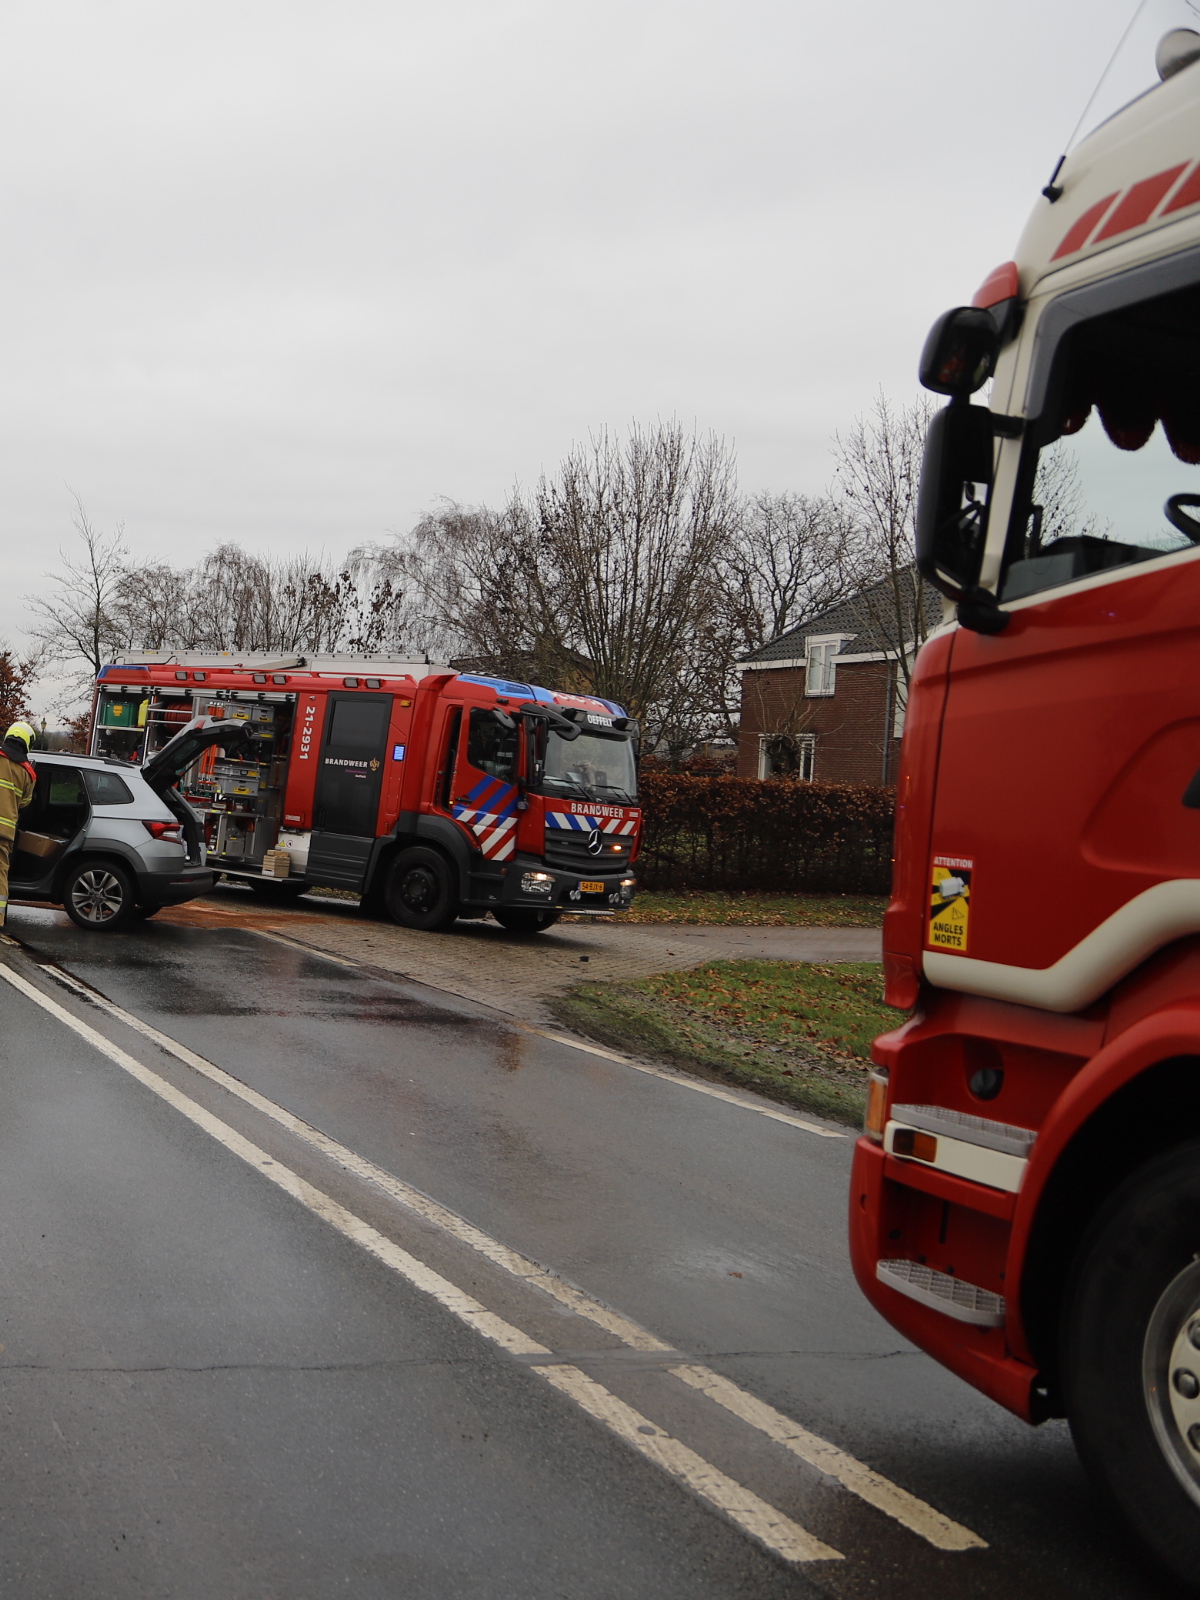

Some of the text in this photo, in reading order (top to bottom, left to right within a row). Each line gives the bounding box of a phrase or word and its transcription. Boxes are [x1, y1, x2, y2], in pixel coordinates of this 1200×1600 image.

[587, 715, 612, 727] OEFFELT
[300, 706, 316, 760] 21-2931
[325, 758, 368, 768] BRANDWEER
[571, 803, 623, 818] BRANDWEER
[933, 856, 973, 869] ATTENTION
[933, 922, 964, 935] ANGLES
[934, 933, 962, 946] MORTS
